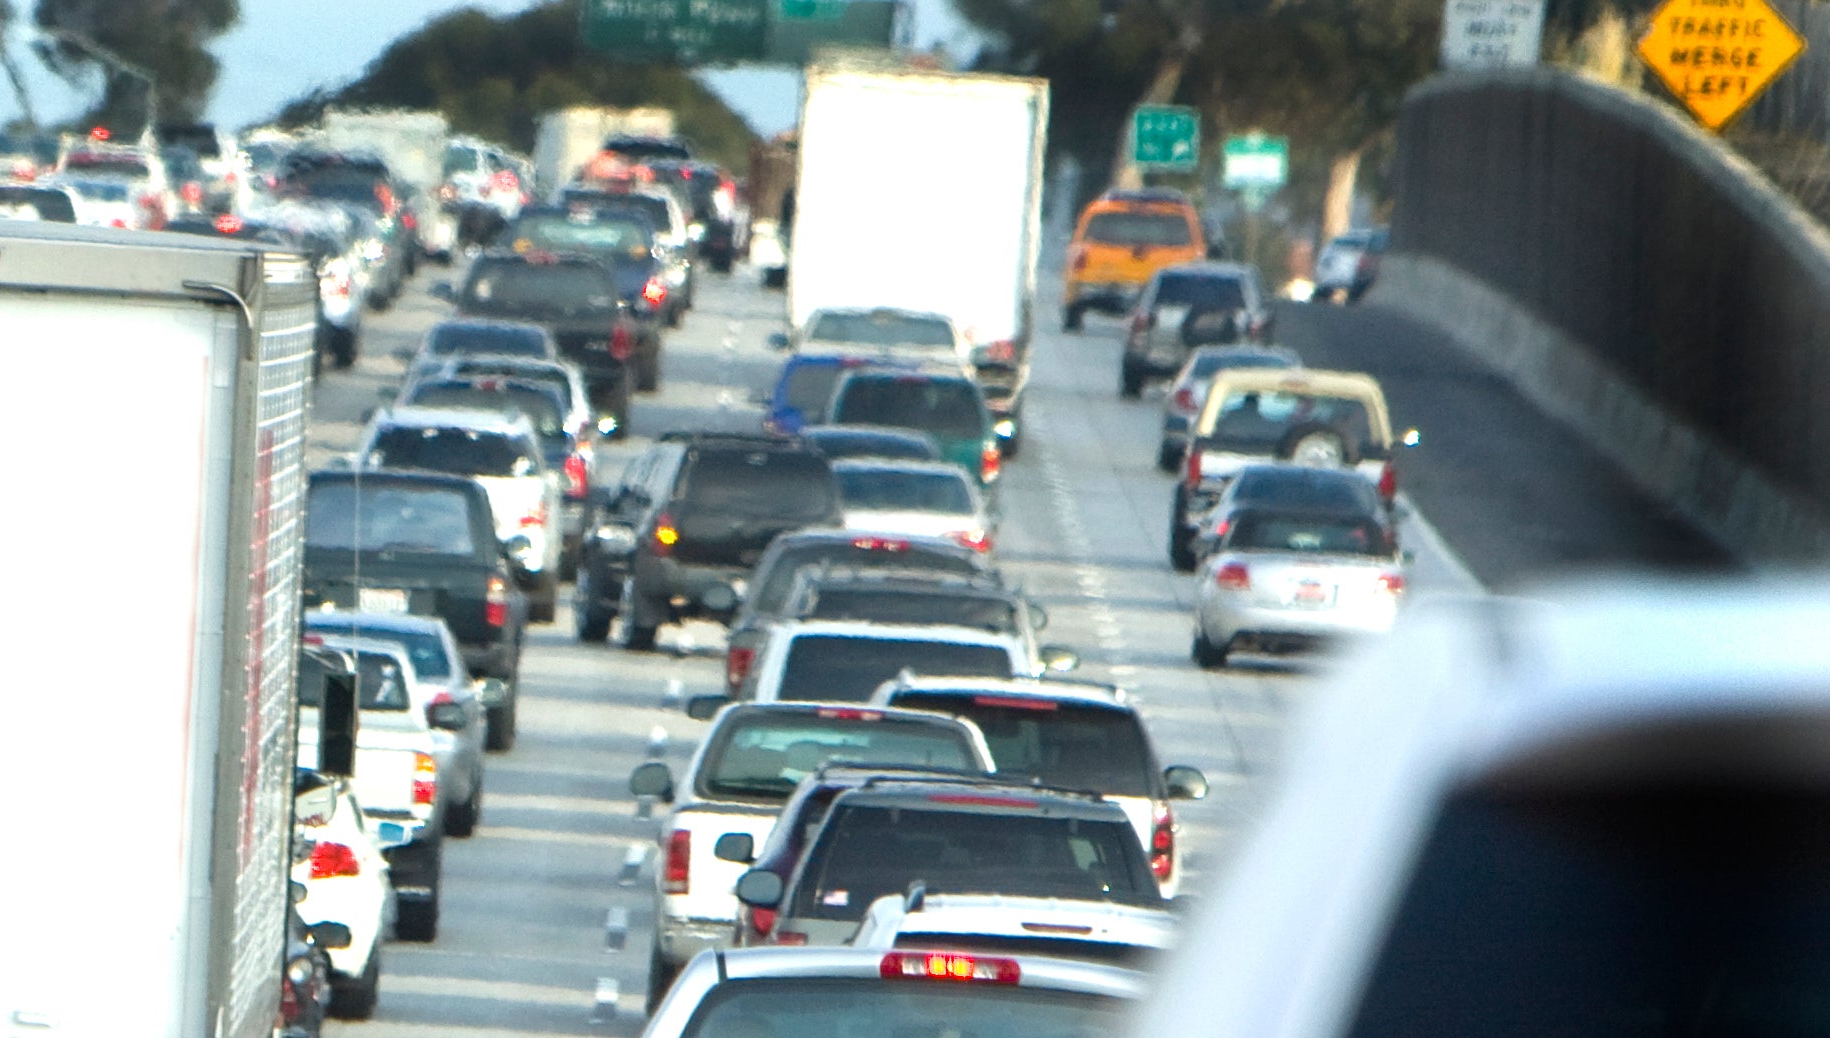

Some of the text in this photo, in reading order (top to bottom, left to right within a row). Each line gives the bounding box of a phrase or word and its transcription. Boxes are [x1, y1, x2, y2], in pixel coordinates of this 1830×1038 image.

[1671, 16, 1766, 37] TRAFFIC
[1671, 46, 1762, 68] MERGE
[1684, 75, 1749, 96] LEFT
